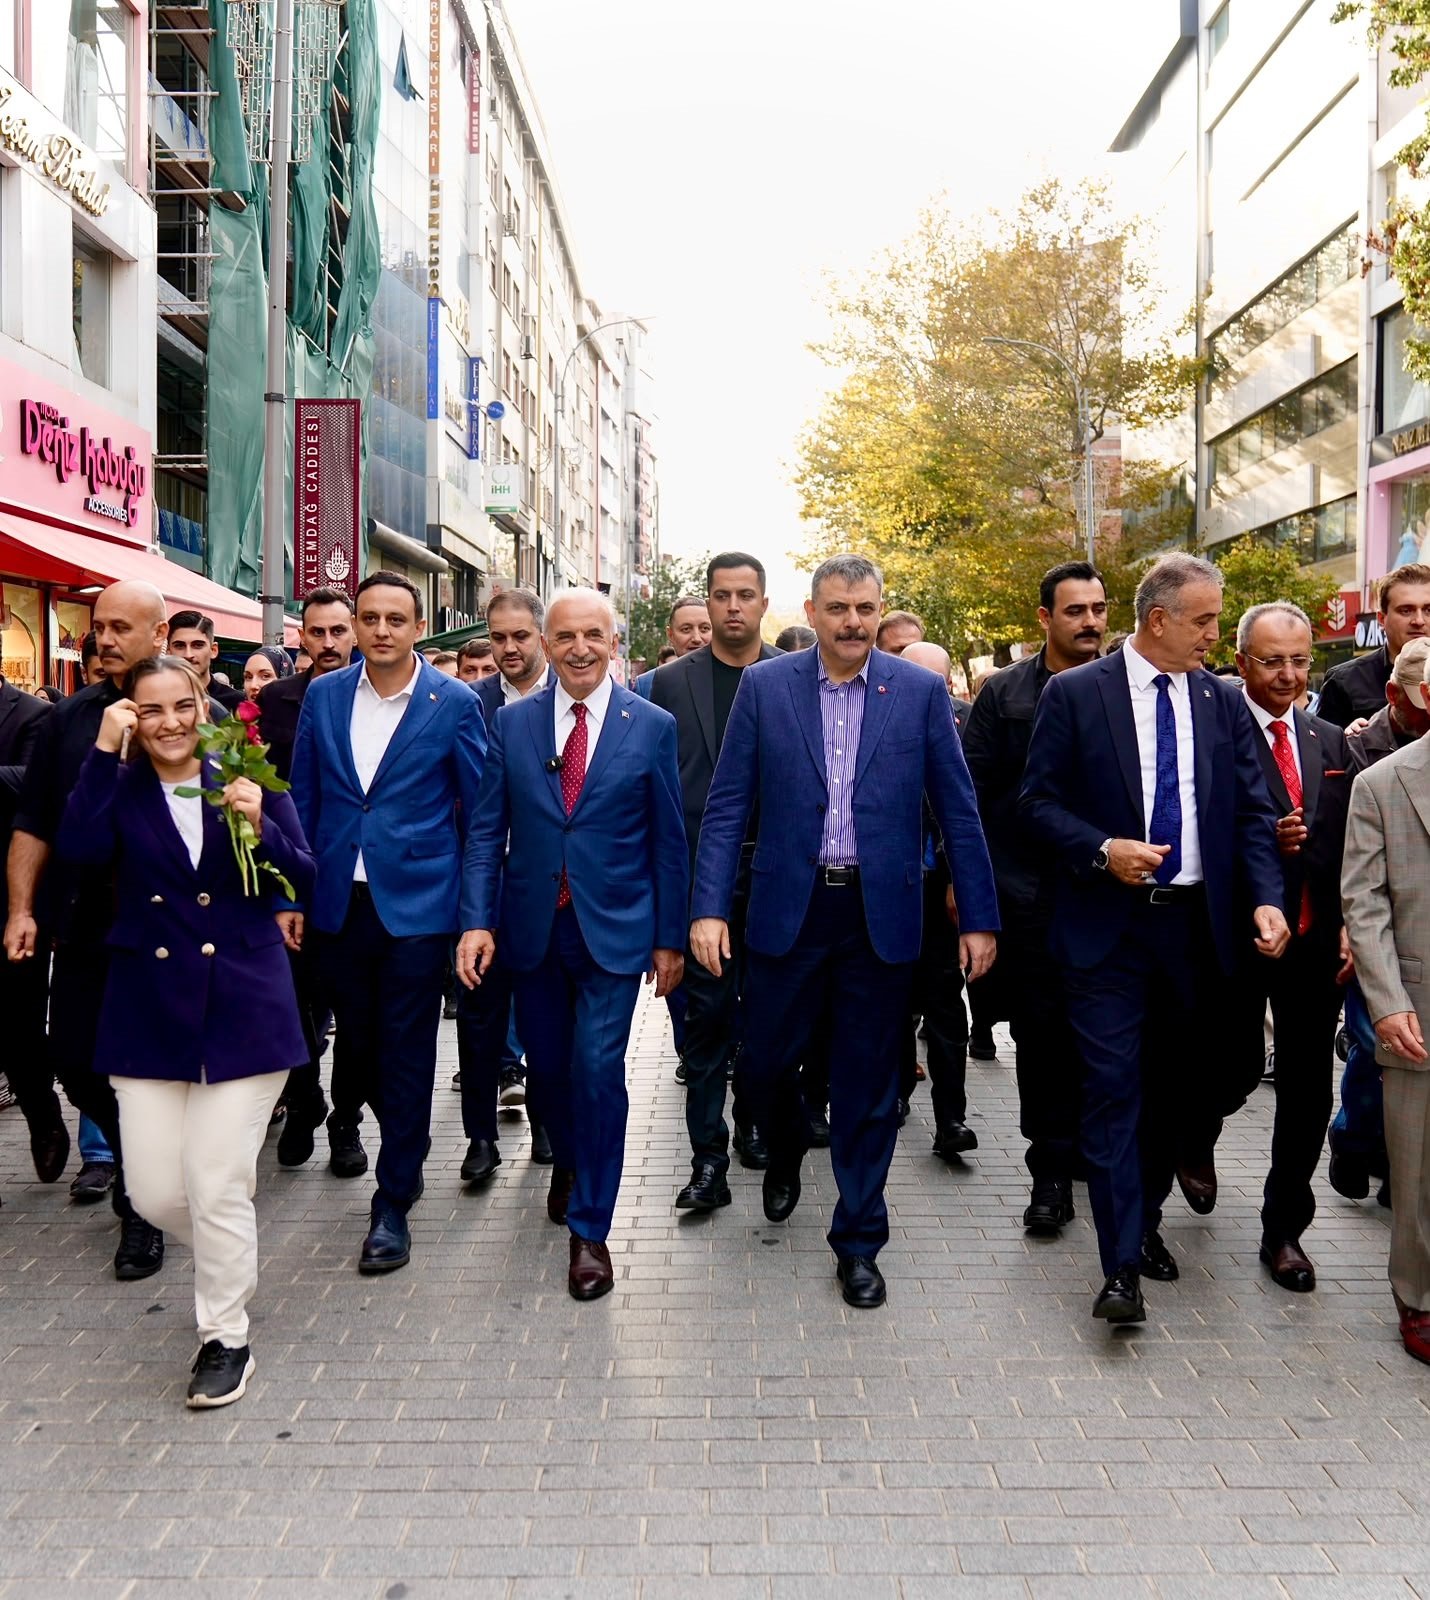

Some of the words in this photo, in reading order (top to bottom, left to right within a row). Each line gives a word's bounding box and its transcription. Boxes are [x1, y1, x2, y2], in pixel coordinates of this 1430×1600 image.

[429, 61, 439, 167] KURSLARI
[20, 399, 79, 483] Deniz
[85, 498, 128, 523] ACCESSORIES
[304, 503, 318, 585] ALEMDAĞ
[328, 581, 347, 589] 2024
